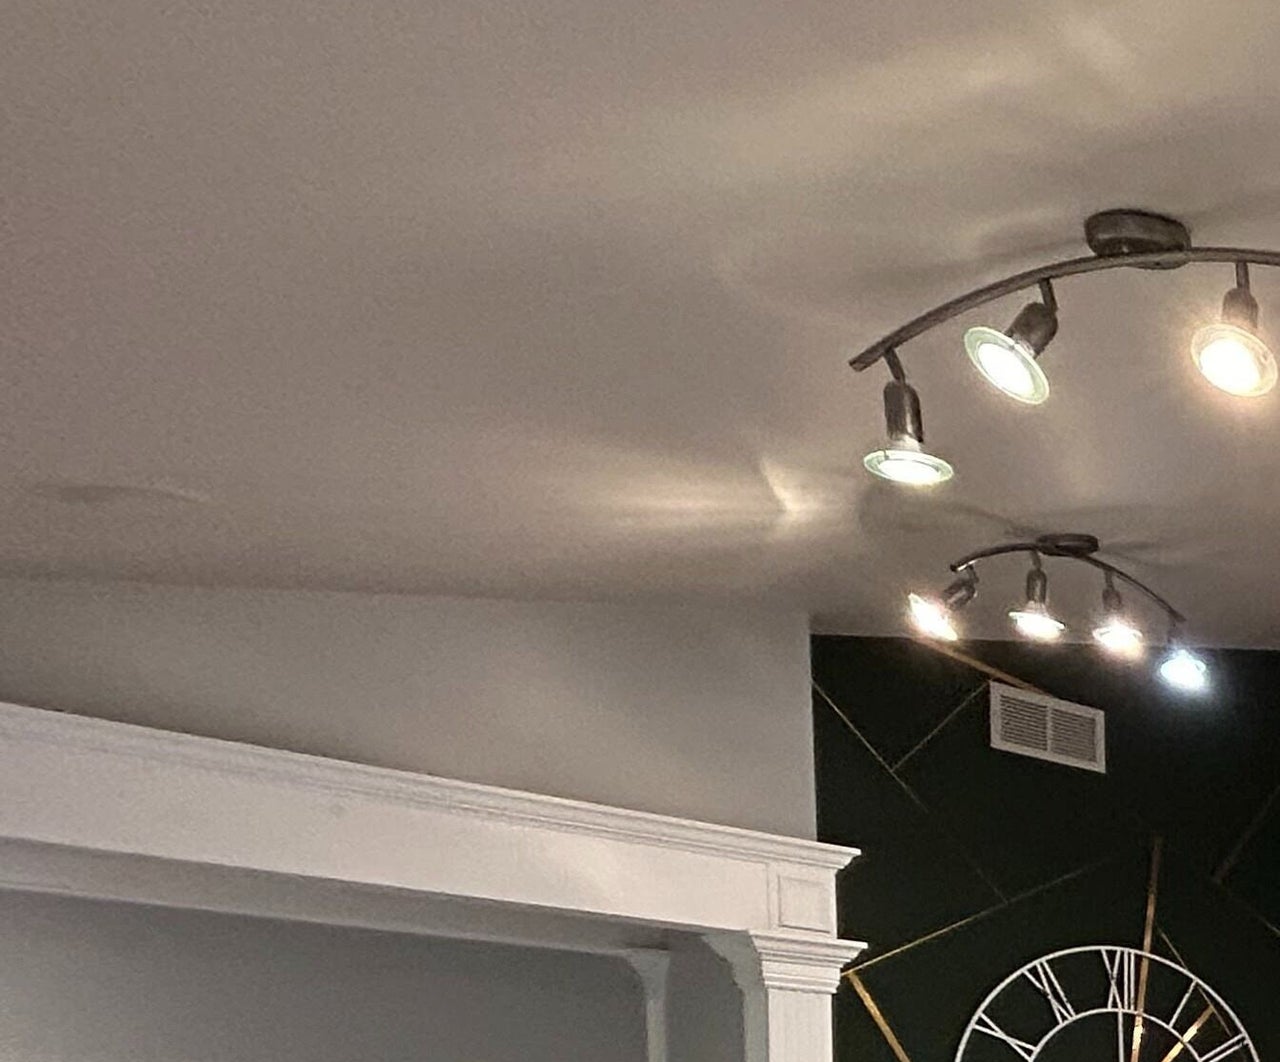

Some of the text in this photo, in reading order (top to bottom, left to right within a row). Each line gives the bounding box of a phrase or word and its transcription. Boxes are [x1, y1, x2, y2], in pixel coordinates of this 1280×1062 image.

[1022, 960, 1076, 1025] XI
[1101, 948, 1135, 1010] XII
[1169, 979, 1198, 1028] I
[974, 1012, 1037, 1062] X
